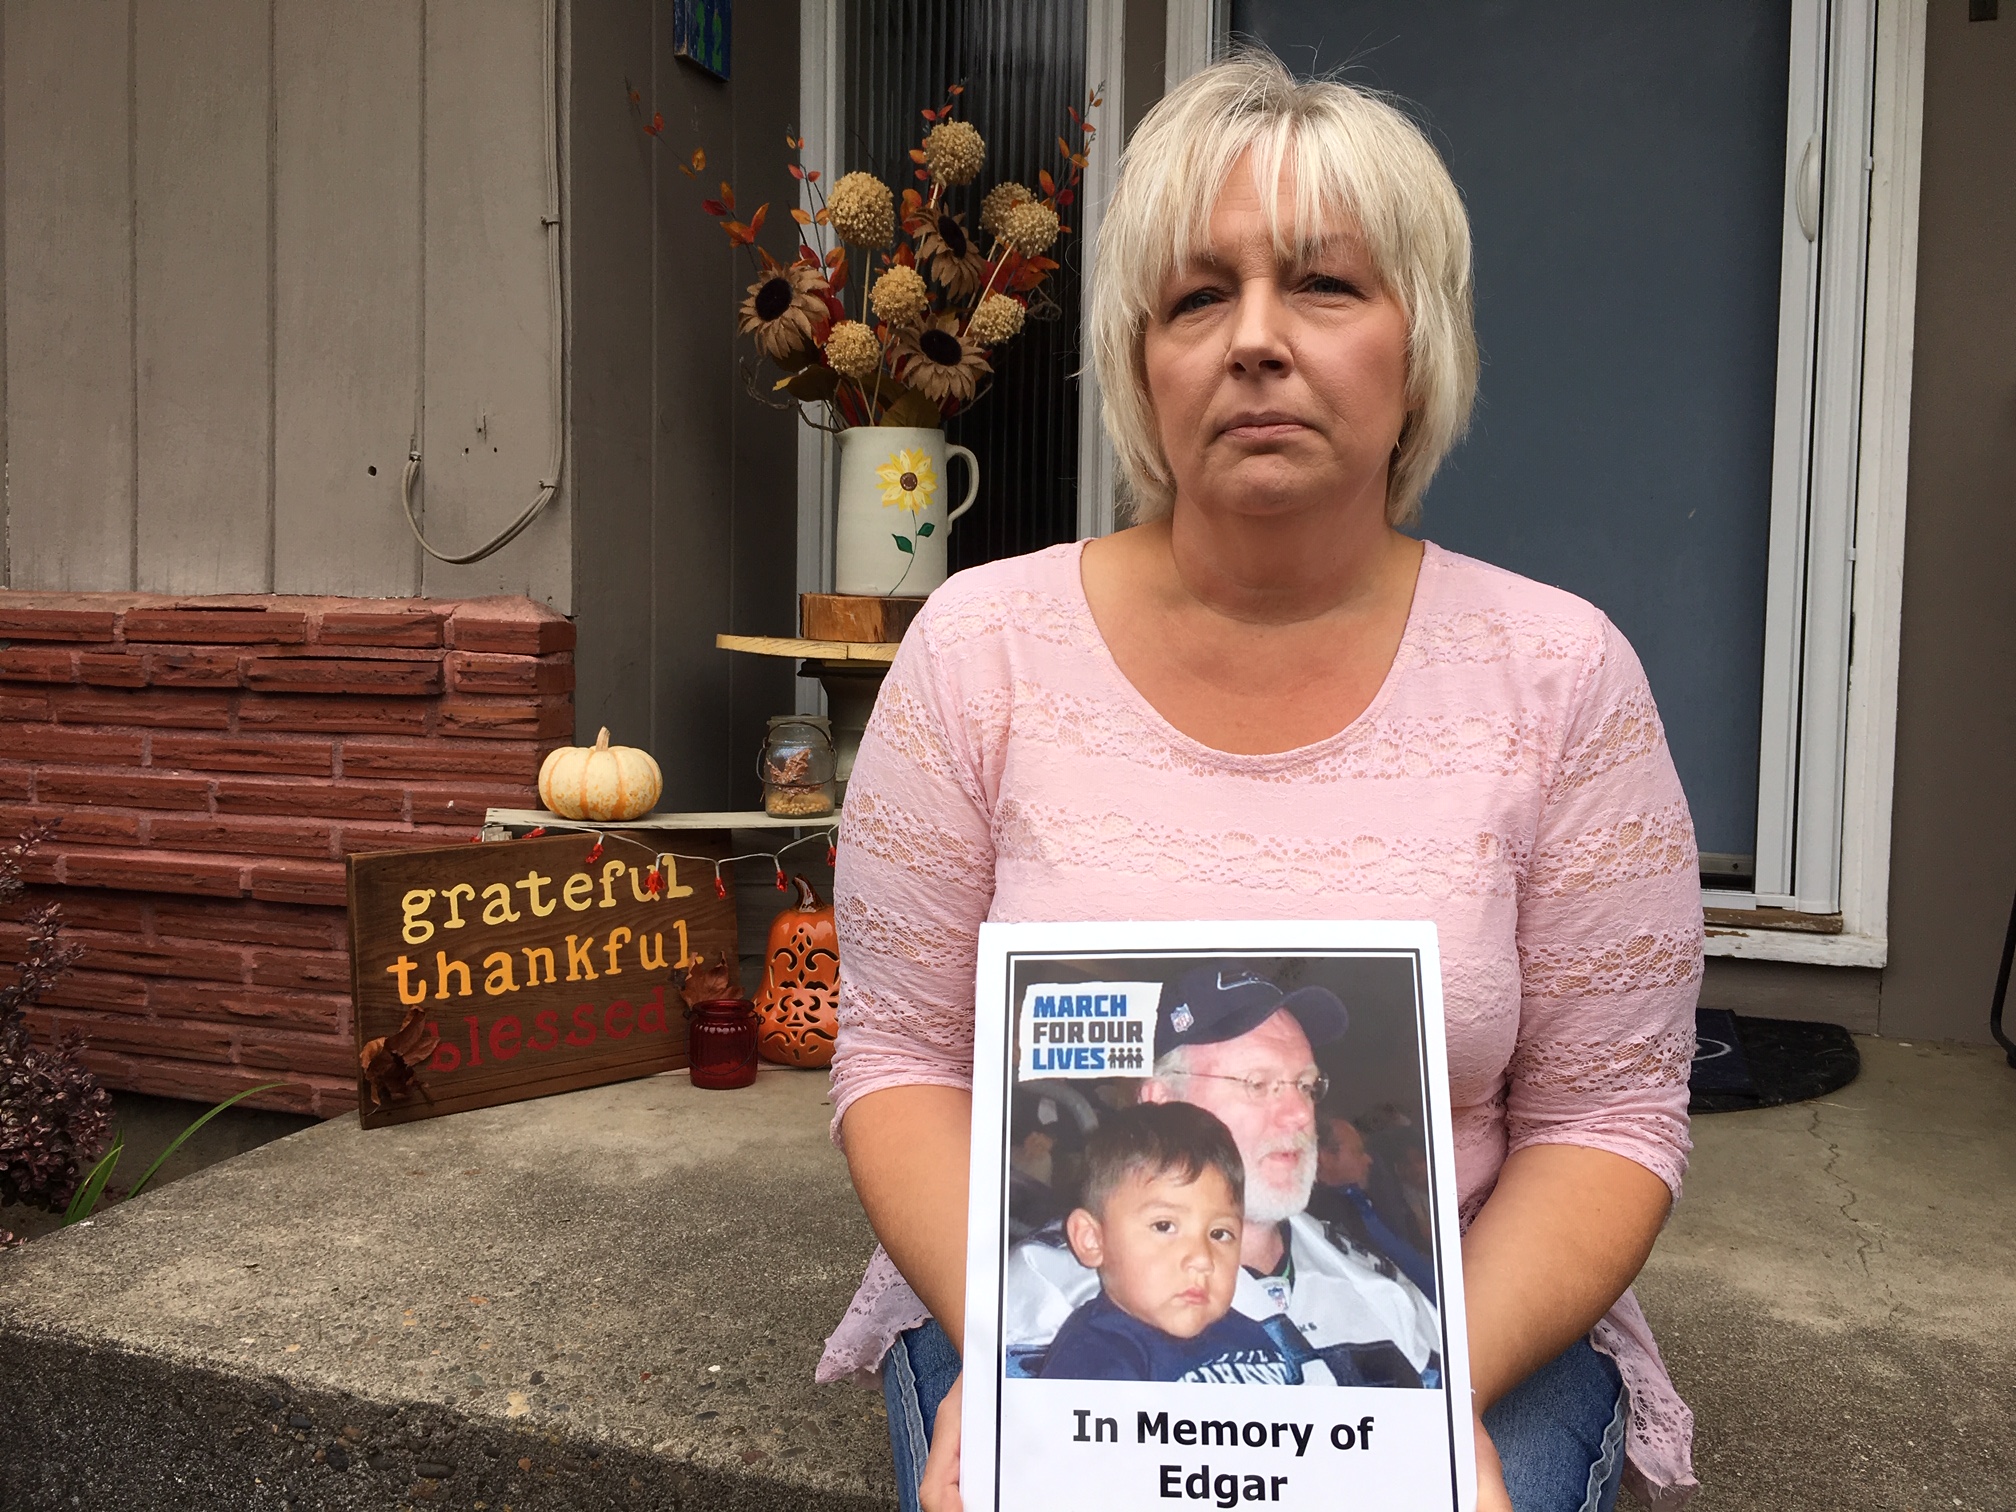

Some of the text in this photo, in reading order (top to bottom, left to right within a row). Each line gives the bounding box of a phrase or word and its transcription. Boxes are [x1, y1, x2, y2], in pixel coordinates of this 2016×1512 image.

[402, 854, 694, 945] grateful
[1033, 994, 1127, 1018] MARCH
[426, 985, 669, 1073] blessed
[1033, 1021, 1143, 1044] FOR OUR
[1032, 1047, 1105, 1070] LIVES
[1073, 1409, 1374, 1456] In Memory of
[1159, 1464, 1288, 1508] Edgar
